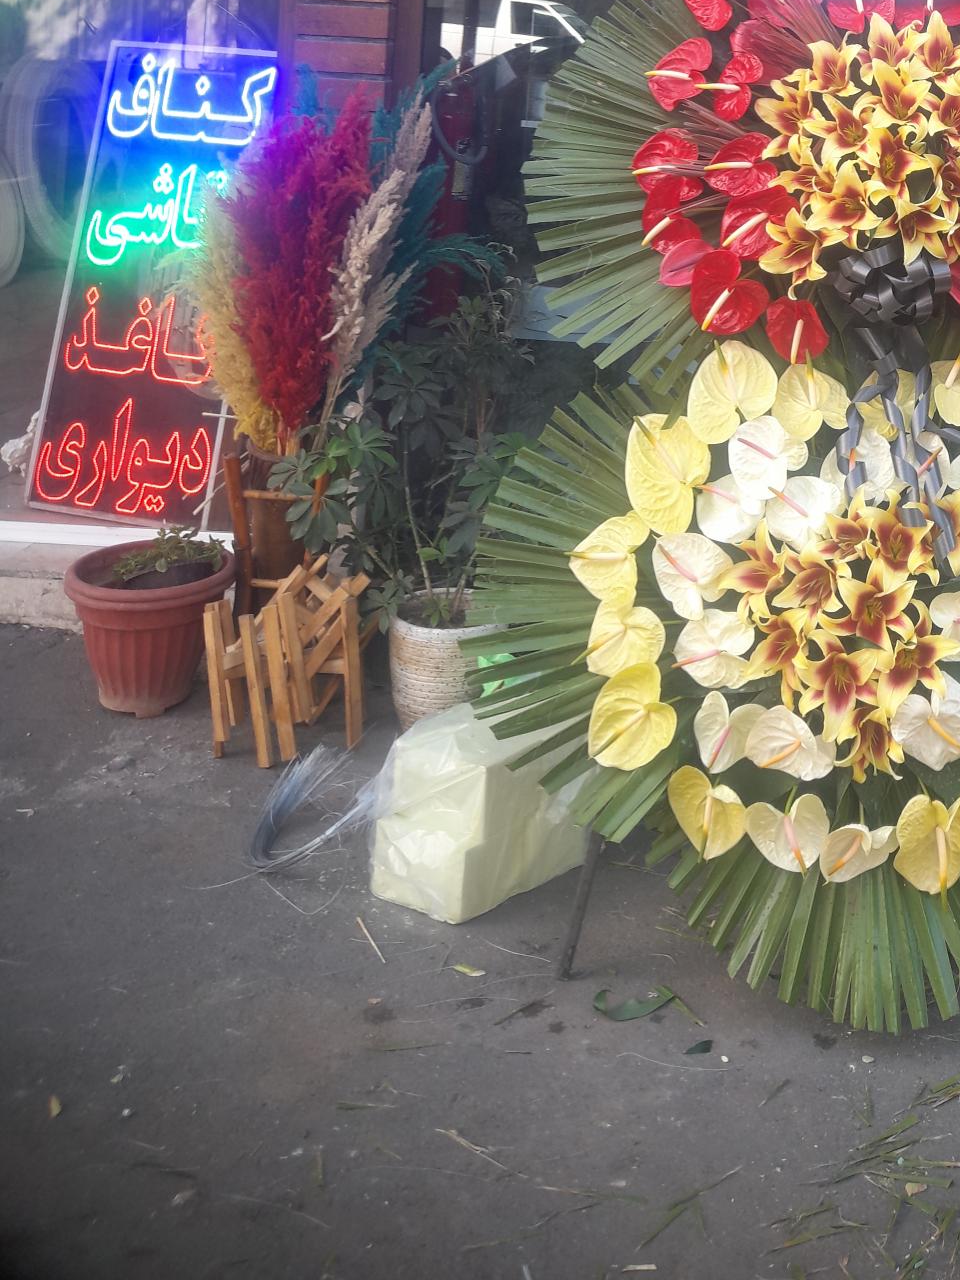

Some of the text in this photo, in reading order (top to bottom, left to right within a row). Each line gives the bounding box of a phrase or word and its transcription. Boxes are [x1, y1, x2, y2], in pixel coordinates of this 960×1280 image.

[106, 52, 277, 147] کناف
[85, 162, 229, 266] اشی
[36, 397, 212, 515] دیواری
